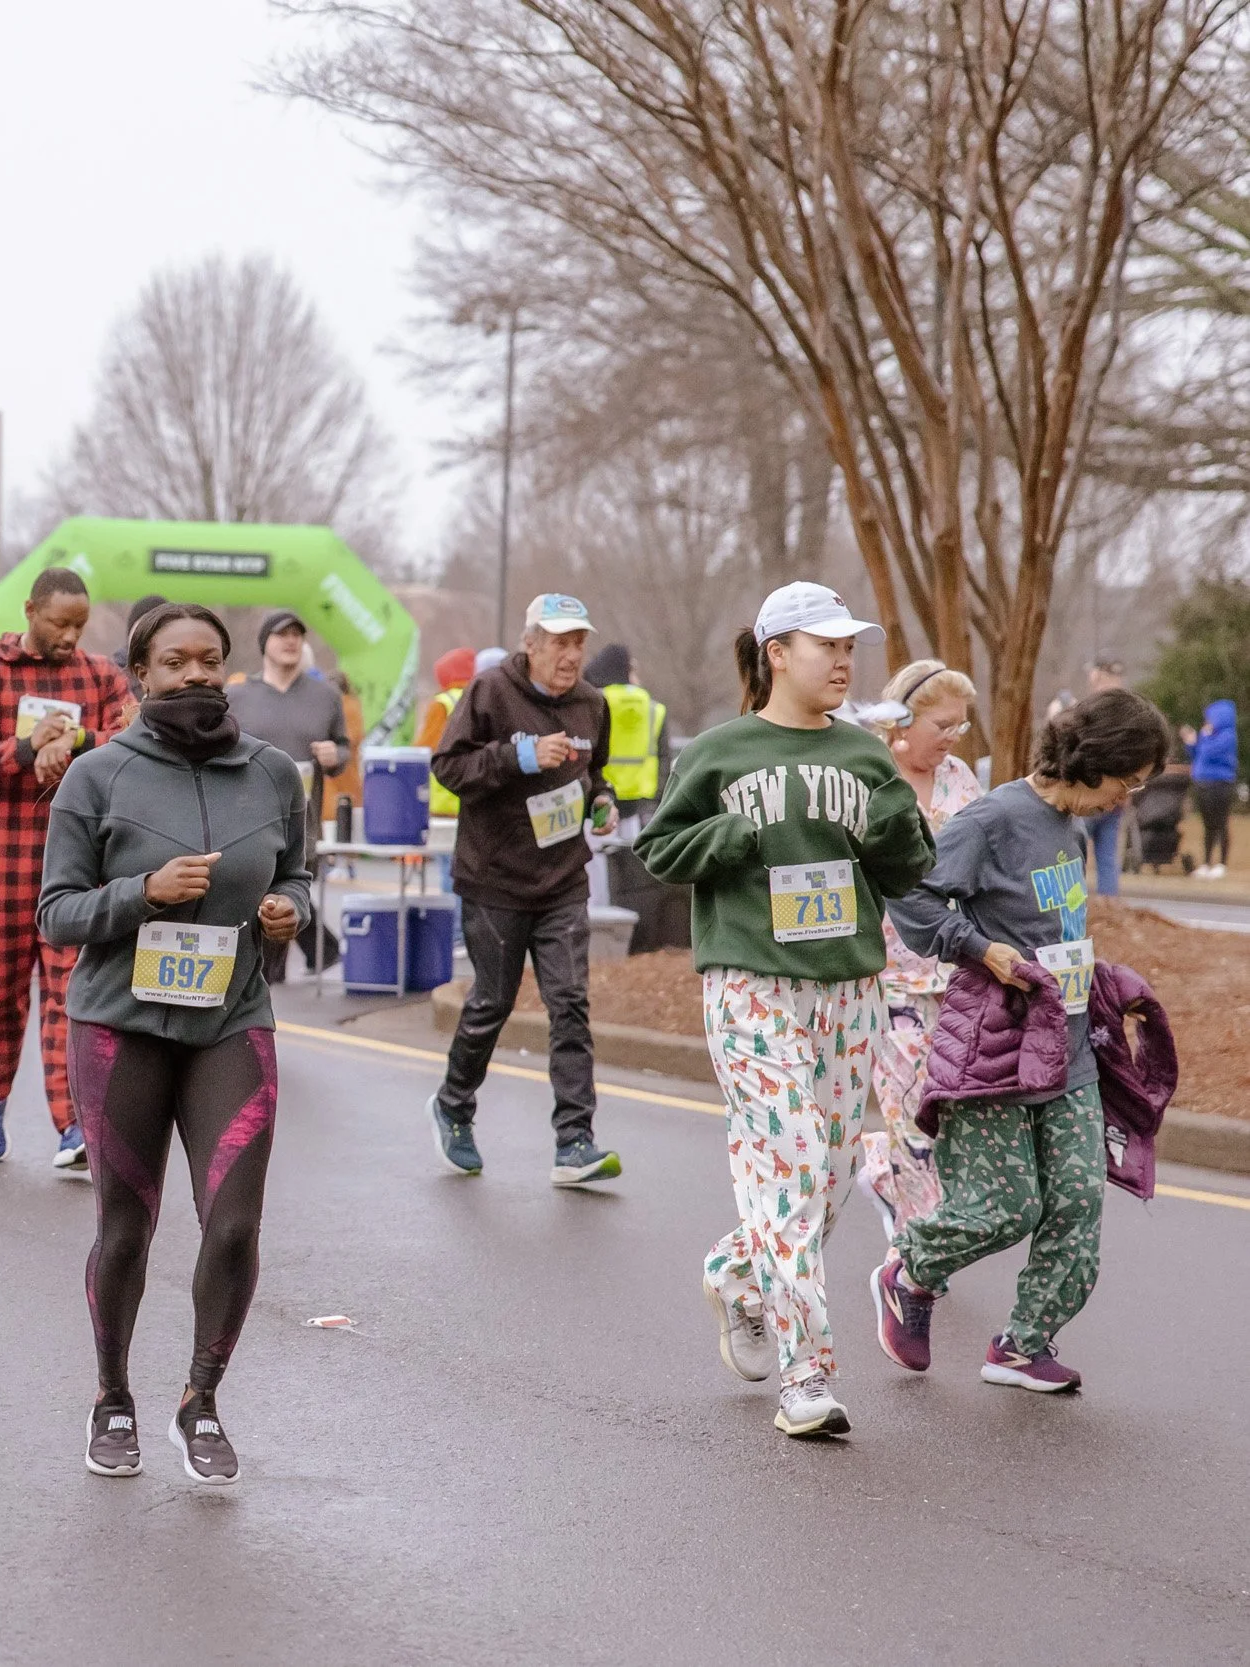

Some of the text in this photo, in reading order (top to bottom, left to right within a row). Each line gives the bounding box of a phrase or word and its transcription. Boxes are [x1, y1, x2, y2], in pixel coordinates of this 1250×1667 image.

[720, 764, 871, 844] NEW YORK
[795, 892, 843, 924] 713
[158, 955, 214, 989] 697
[144, 991, 218, 1002] www.FiveStarNTP.com
[108, 1416, 133, 1430] NIKE
[195, 1420, 220, 1435] NIKE
